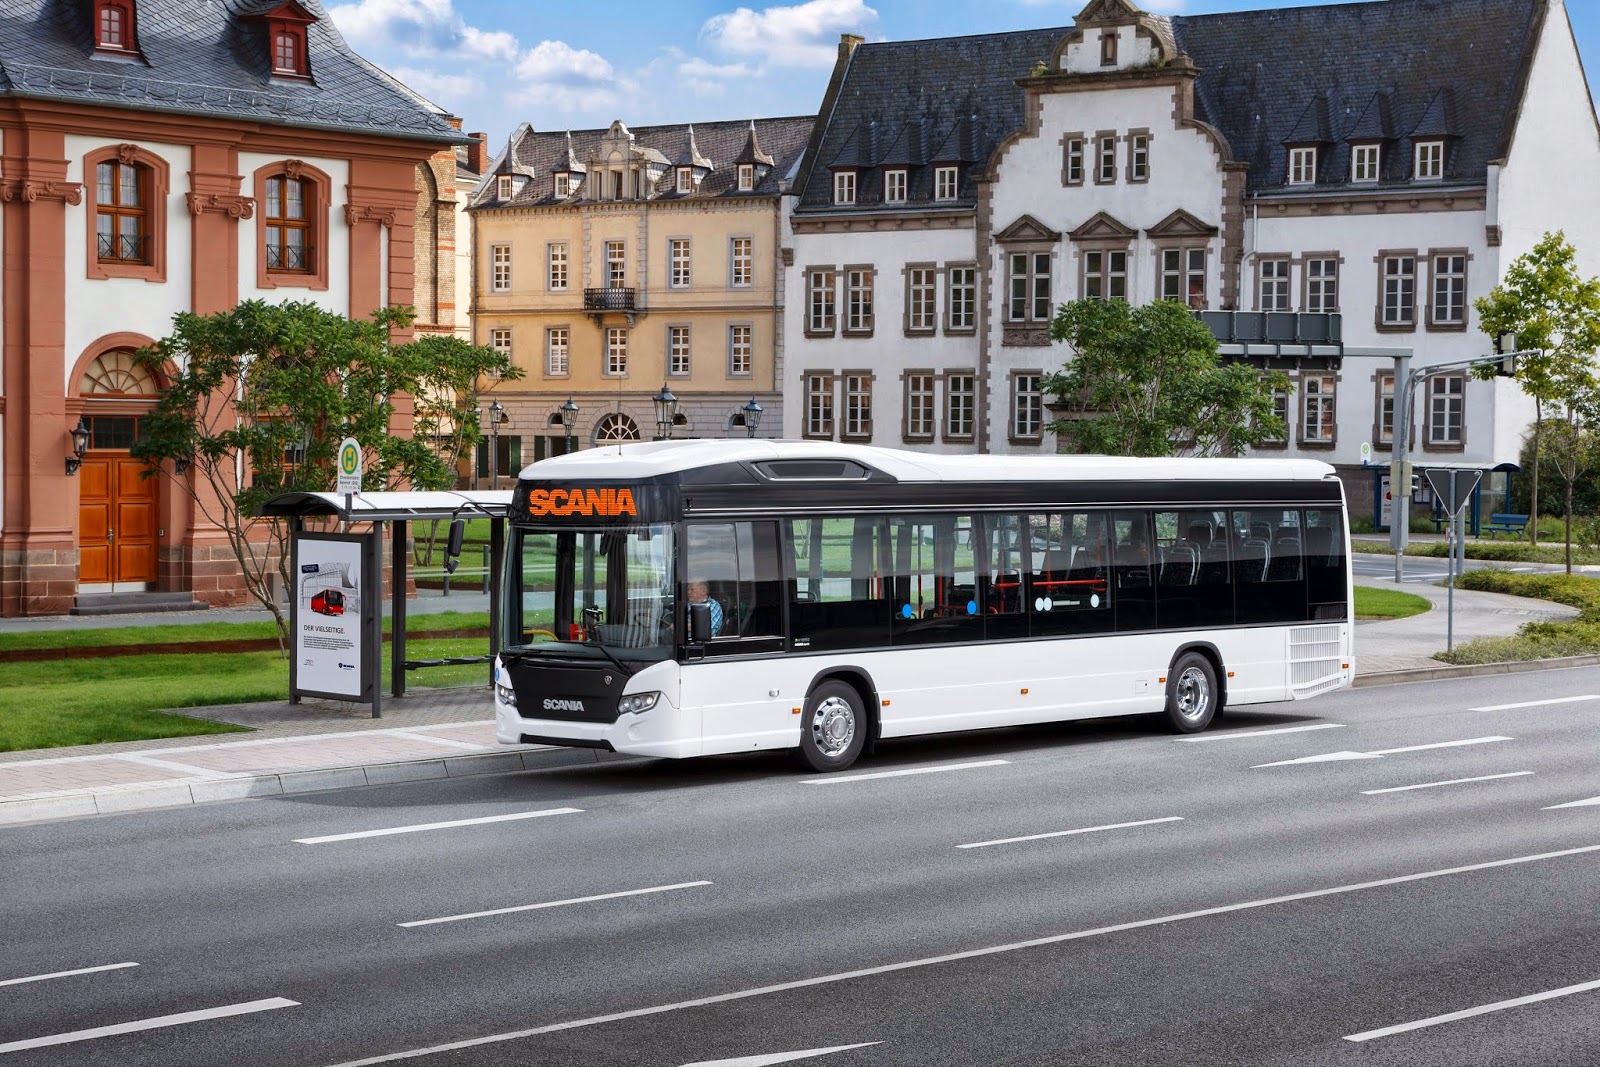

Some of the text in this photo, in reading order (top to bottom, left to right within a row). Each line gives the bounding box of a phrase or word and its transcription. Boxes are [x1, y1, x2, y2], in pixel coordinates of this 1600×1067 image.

[346, 450, 354, 467] H
[529, 488, 637, 516] SCANIA
[543, 698, 585, 712] SCANIA
